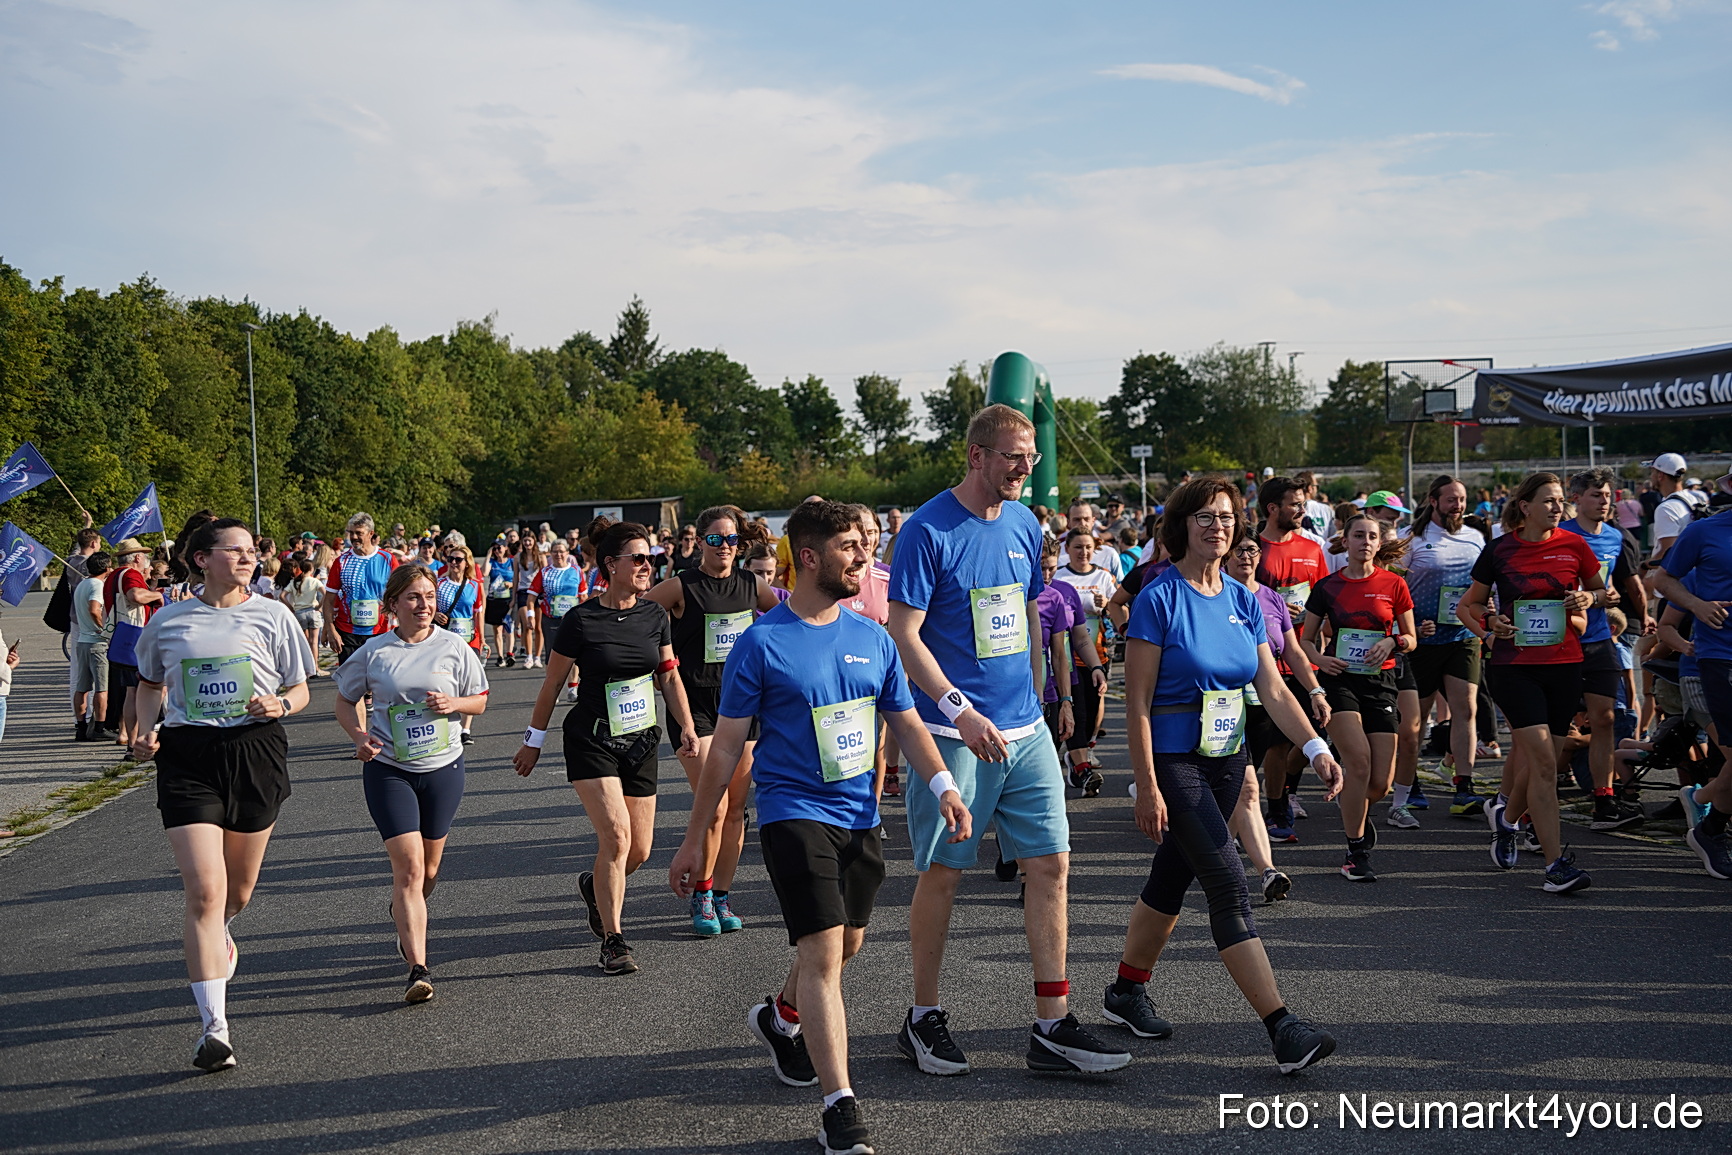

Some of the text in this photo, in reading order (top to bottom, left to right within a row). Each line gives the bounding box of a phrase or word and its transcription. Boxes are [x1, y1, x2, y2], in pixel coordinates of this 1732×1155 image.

[1542, 387, 1582, 414] Hier
[1581, 381, 1665, 421] gewinnt
[1664, 377, 1707, 408] das
[991, 614, 1016, 630] 947
[1529, 619, 1549, 629] 721
[989, 632, 1010, 640] Michael
[853, 655, 870, 665] Berger
[198, 681, 238, 696] 4010
[195, 698, 224, 709] BEYER,
[618, 698, 646, 715] 1093
[406, 724, 435, 739] 1519
[1214, 717, 1237, 732] 965
[836, 731, 864, 751] 962
[836, 754, 850, 762] Hedi
